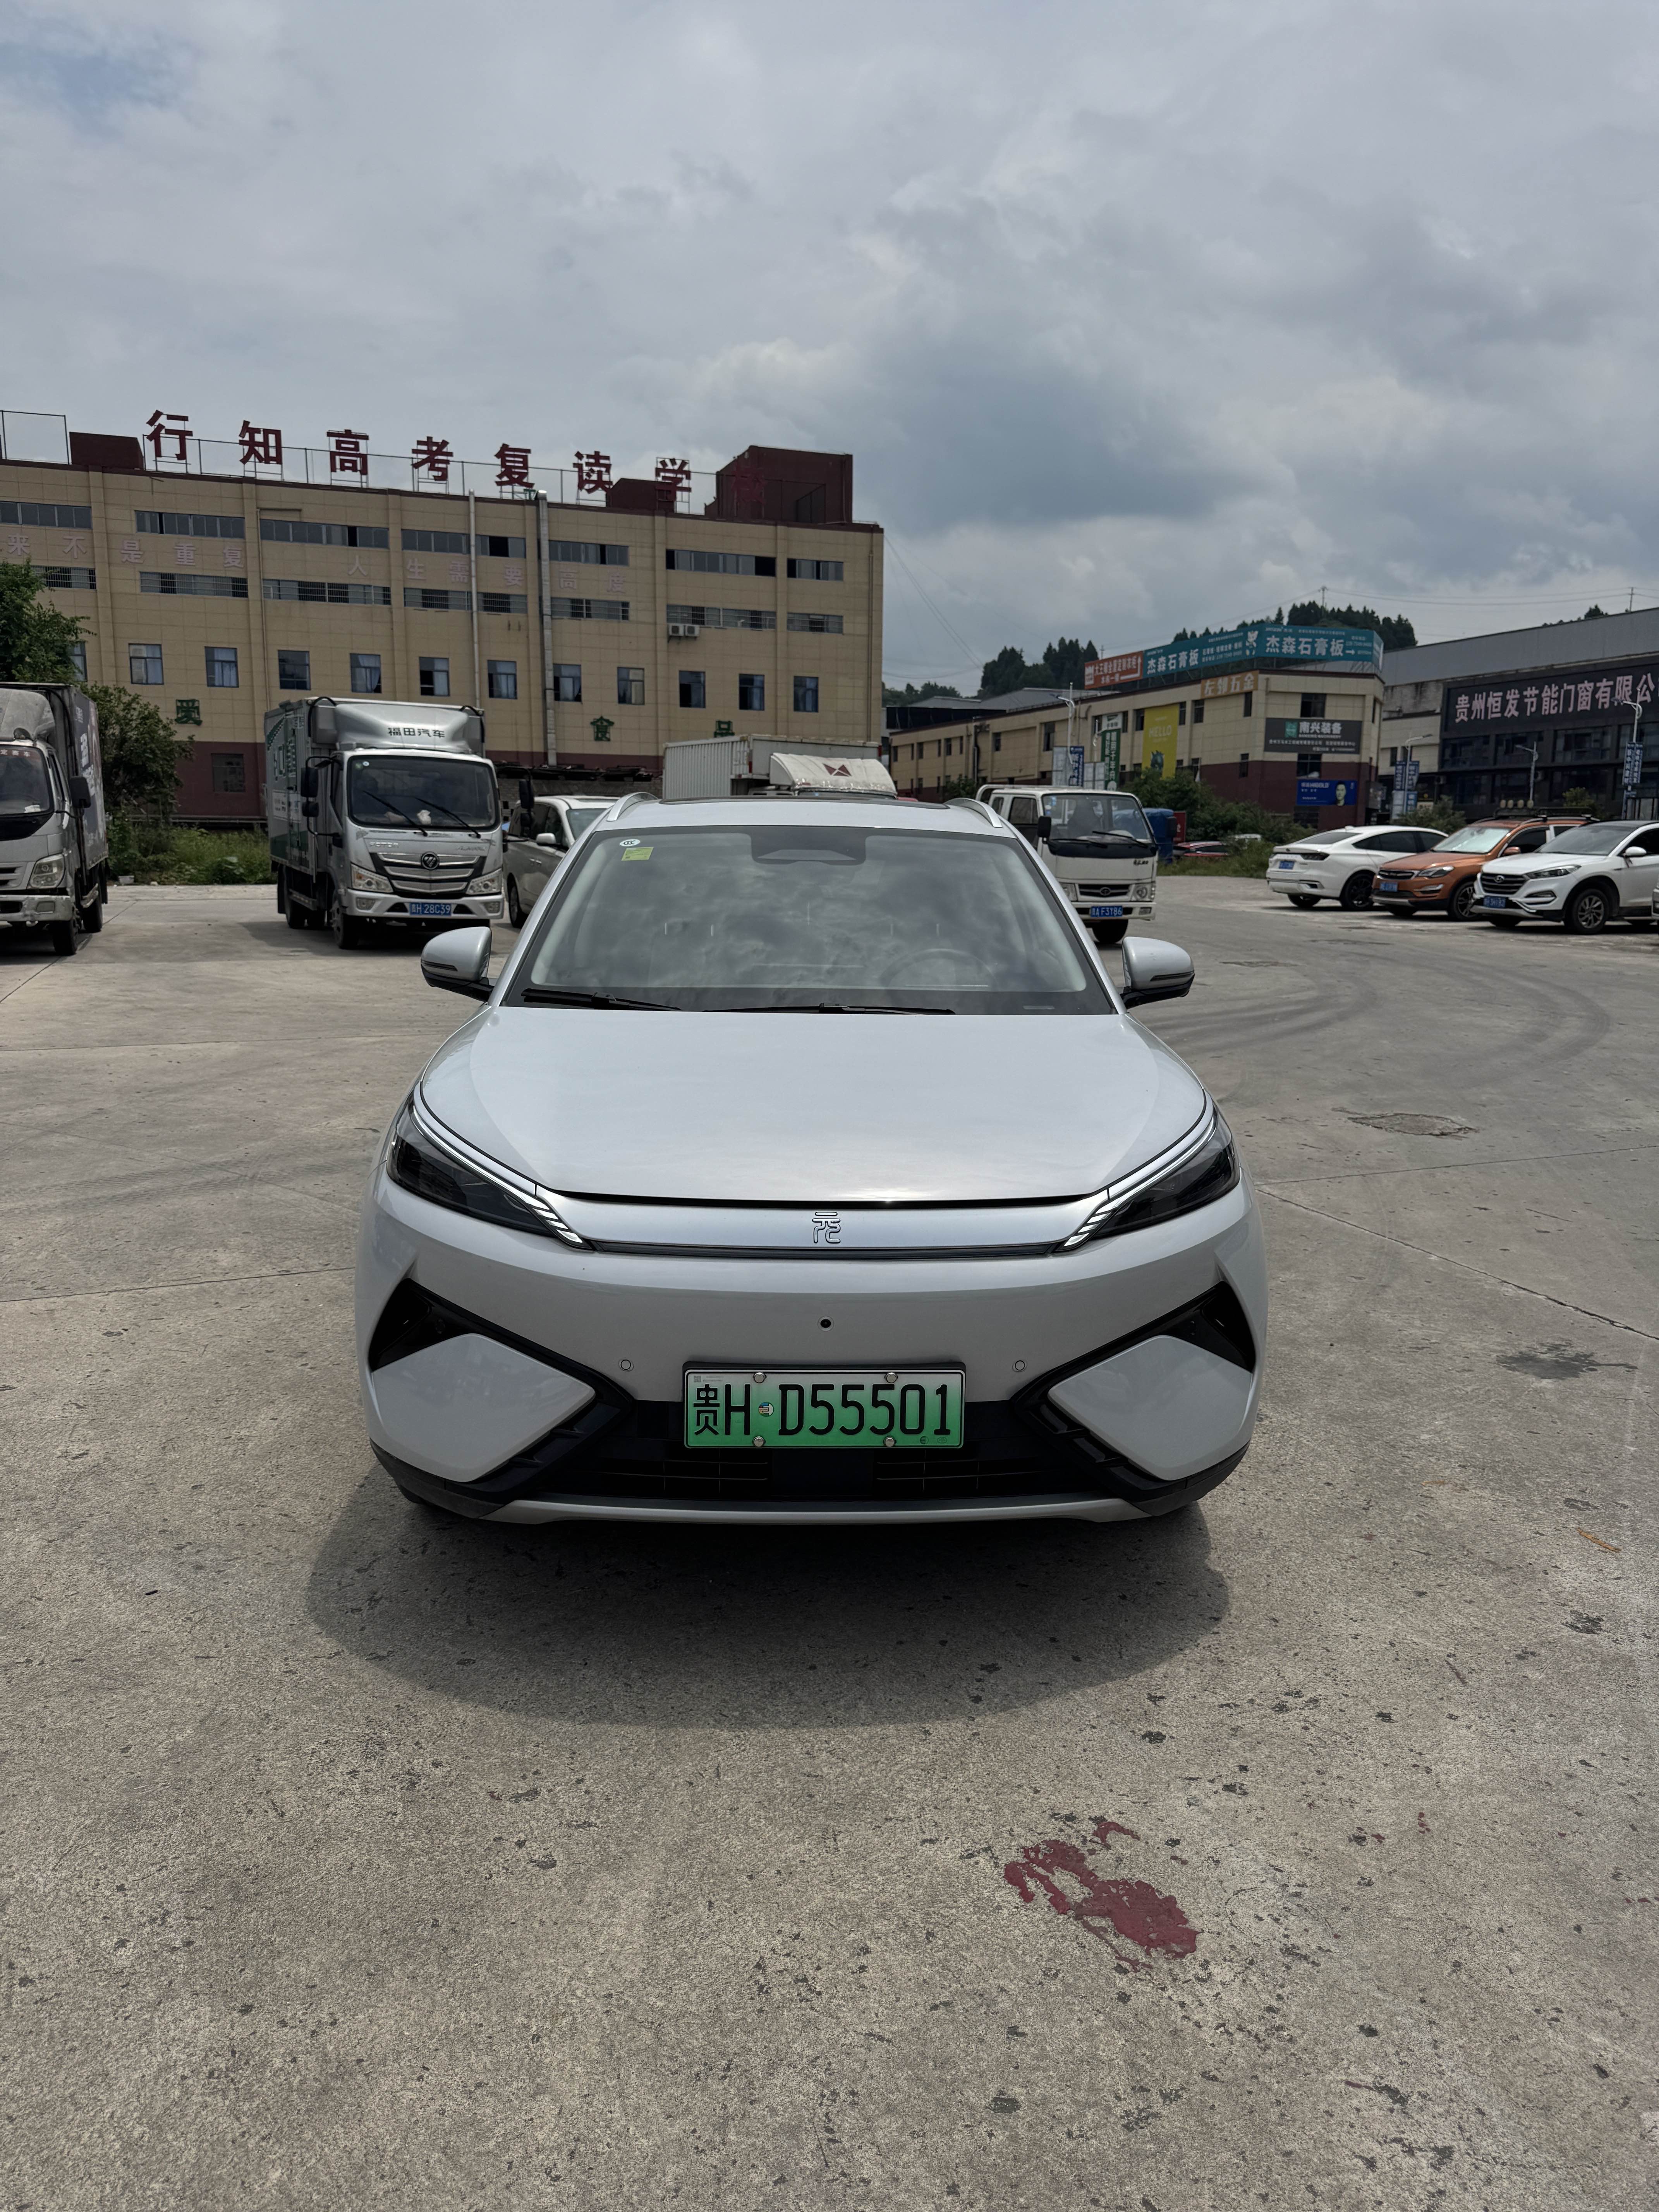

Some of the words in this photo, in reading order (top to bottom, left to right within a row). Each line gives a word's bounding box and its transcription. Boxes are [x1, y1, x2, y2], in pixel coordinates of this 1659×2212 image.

[1266, 635, 1344, 657] 杰森石膏板
[1147, 649, 1199, 675] 杰森石膏板
[1455, 673, 1659, 723] 贵州恒发节能门窗有限公
[388, 727, 445, 738] 福田汽车
[1149, 725, 1172, 738] HELLO
